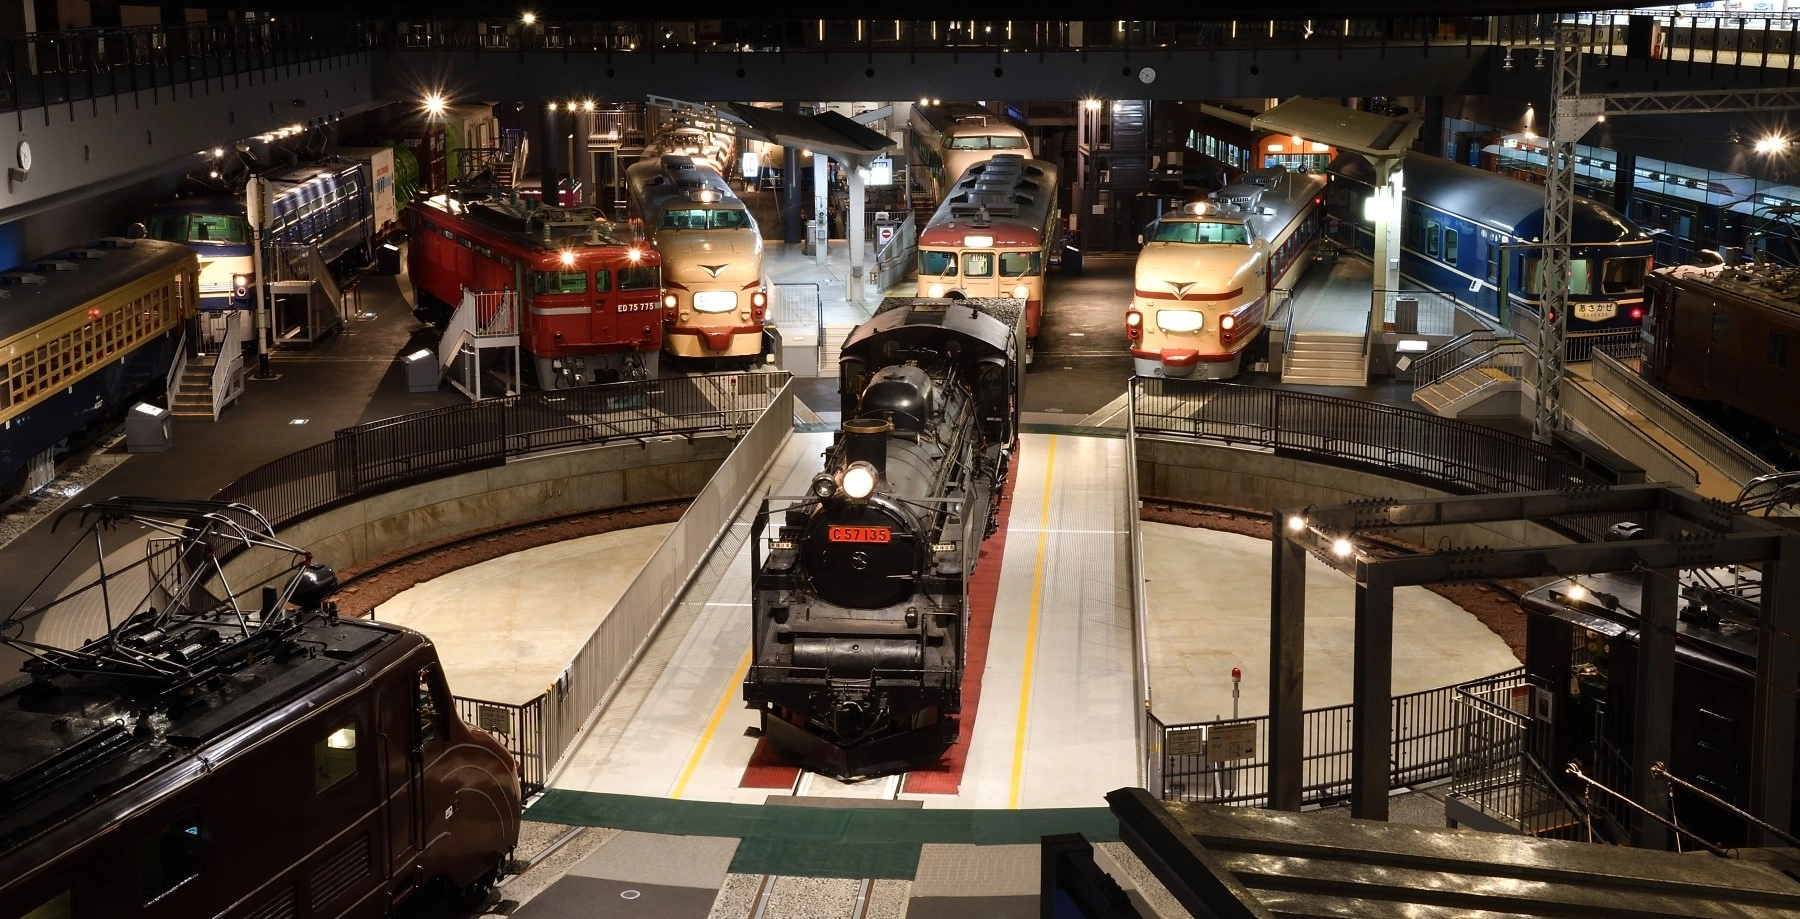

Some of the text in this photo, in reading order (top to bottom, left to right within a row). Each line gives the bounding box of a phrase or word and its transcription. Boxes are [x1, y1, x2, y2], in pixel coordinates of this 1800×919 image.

[617, 302, 654, 313] ED 75 775
[1579, 304, 1613, 312] あさかぜ
